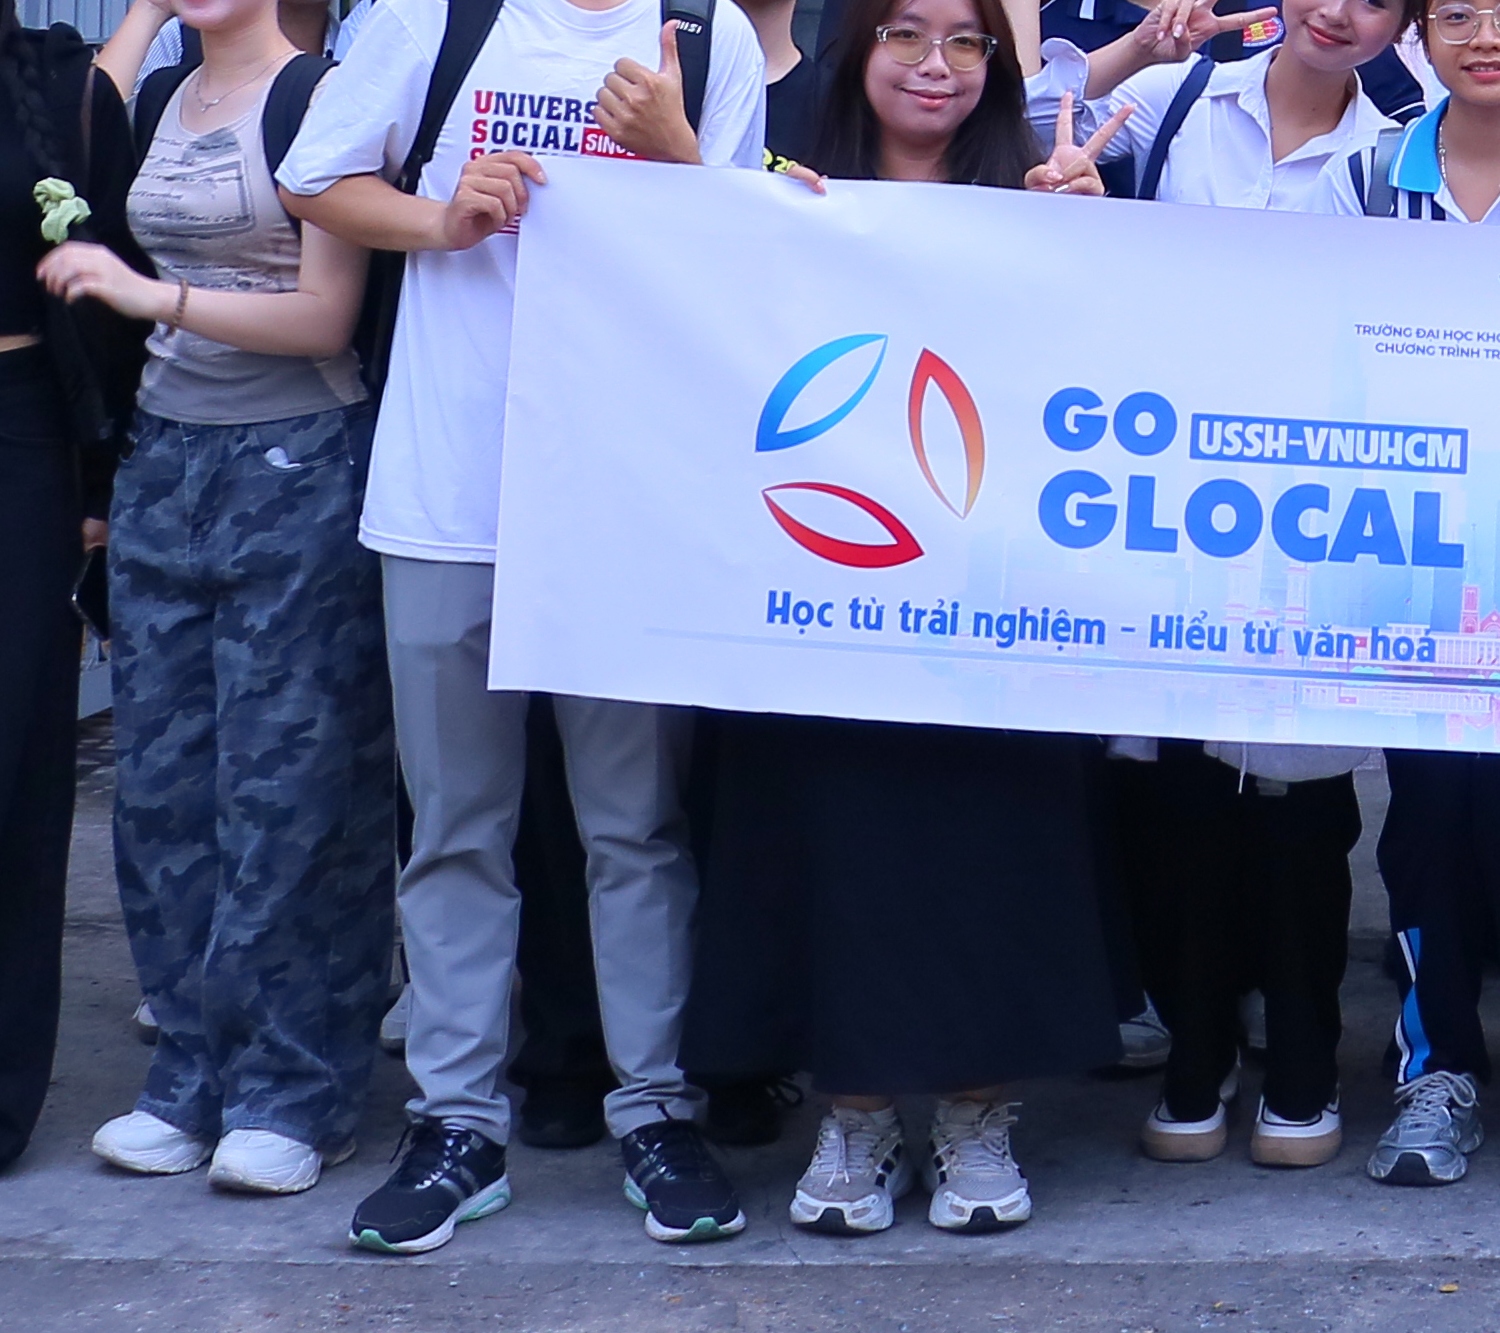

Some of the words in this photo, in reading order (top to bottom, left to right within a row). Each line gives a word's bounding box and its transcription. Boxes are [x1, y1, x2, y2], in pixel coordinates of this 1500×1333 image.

[472, 119, 579, 151] SOCIAL
[1355, 323, 1412, 338] TRƯỜNG
[1415, 328, 1439, 342] ĐẠI
[1444, 331, 1473, 343] HỌC
[1375, 342, 1436, 356] CHƯƠNG
[1439, 344, 1480, 358] TRÌNH
[1043, 386, 1178, 457] GO
[1197, 419, 1462, 470] USSH-VNUHCM
[1038, 470, 1465, 568] GLOCAL
[767, 591, 833, 637] Học
[849, 595, 885, 630] từ
[901, 599, 958, 638] trải
[974, 607, 1105, 652] nghiệm
[1150, 611, 1228, 653] Hiểu
[1245, 615, 1279, 655] từ
[1293, 625, 1356, 662] văn
[1371, 630, 1437, 664] hoá
